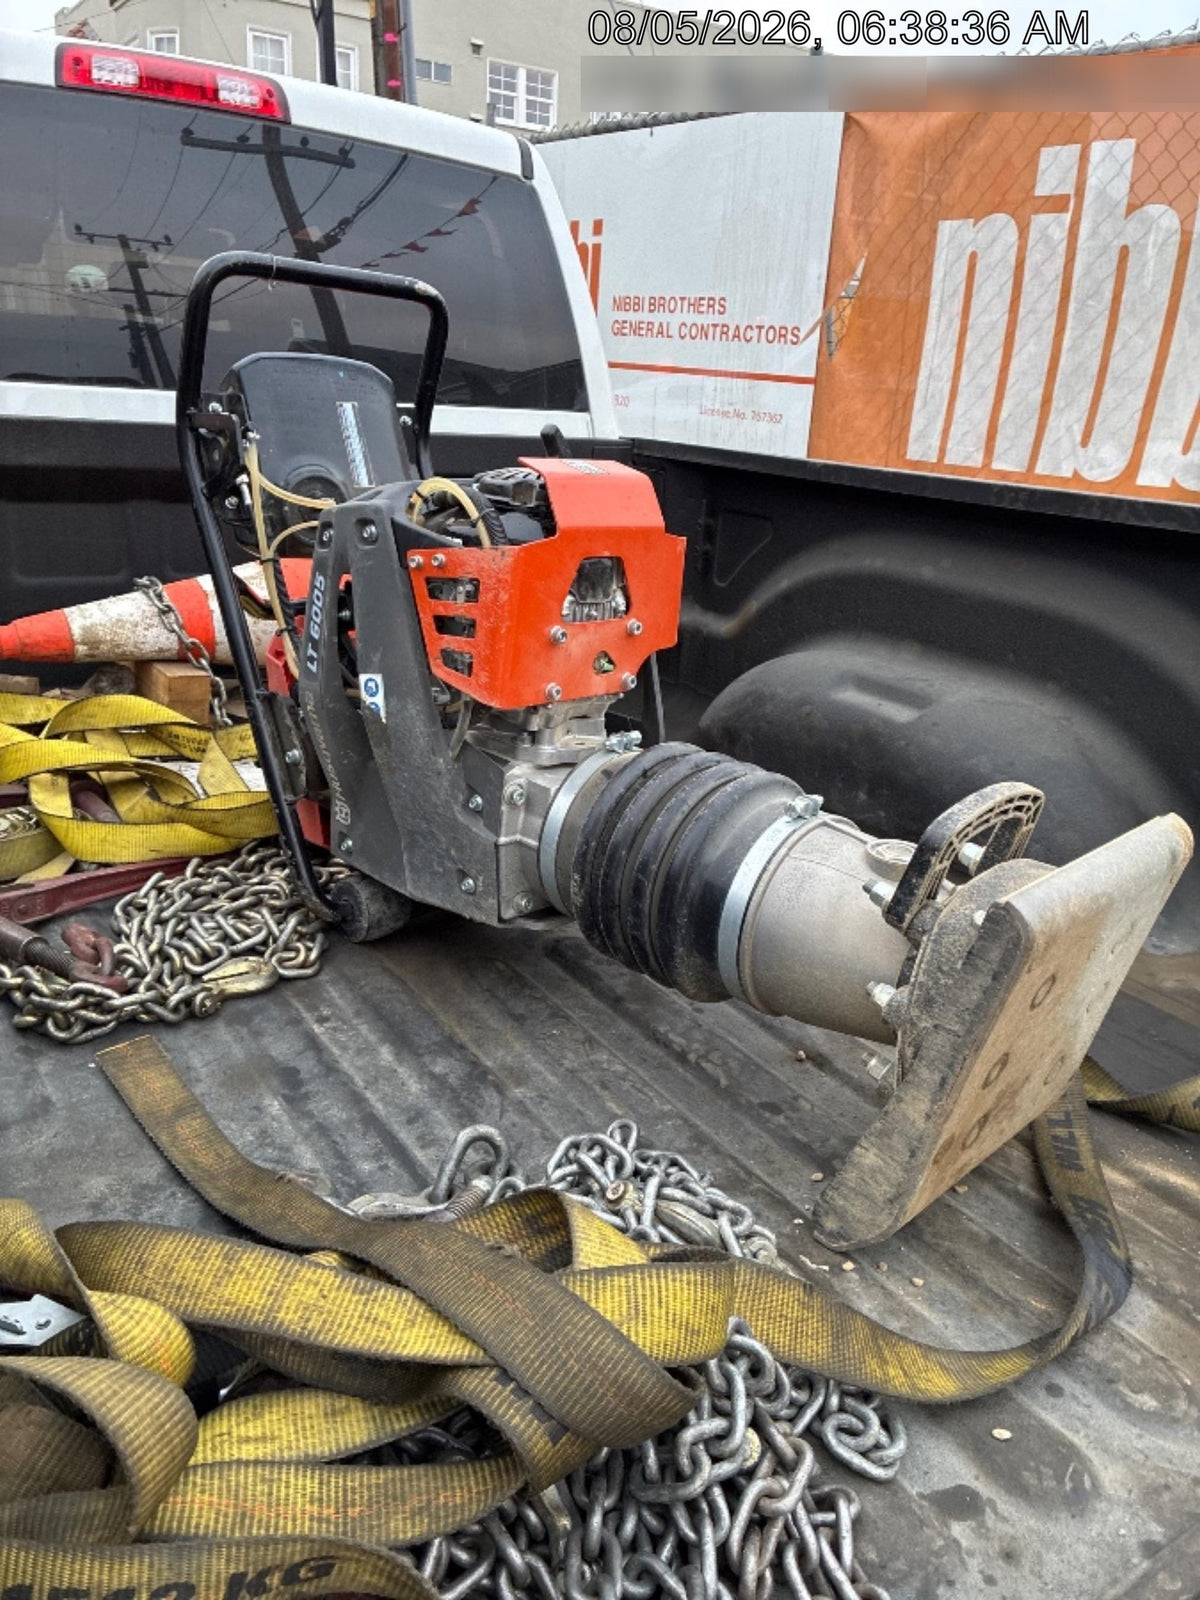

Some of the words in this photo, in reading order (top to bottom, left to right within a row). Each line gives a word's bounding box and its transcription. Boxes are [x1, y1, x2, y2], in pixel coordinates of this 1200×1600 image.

[611, 295, 645, 313] NIBBI
[648, 296, 727, 316] BROTHERS
[611, 319, 674, 339] GENERAL
[678, 322, 801, 346] CONTRACTORS
[310, 572, 325, 640] 6005
[307, 642, 318, 673] LT
